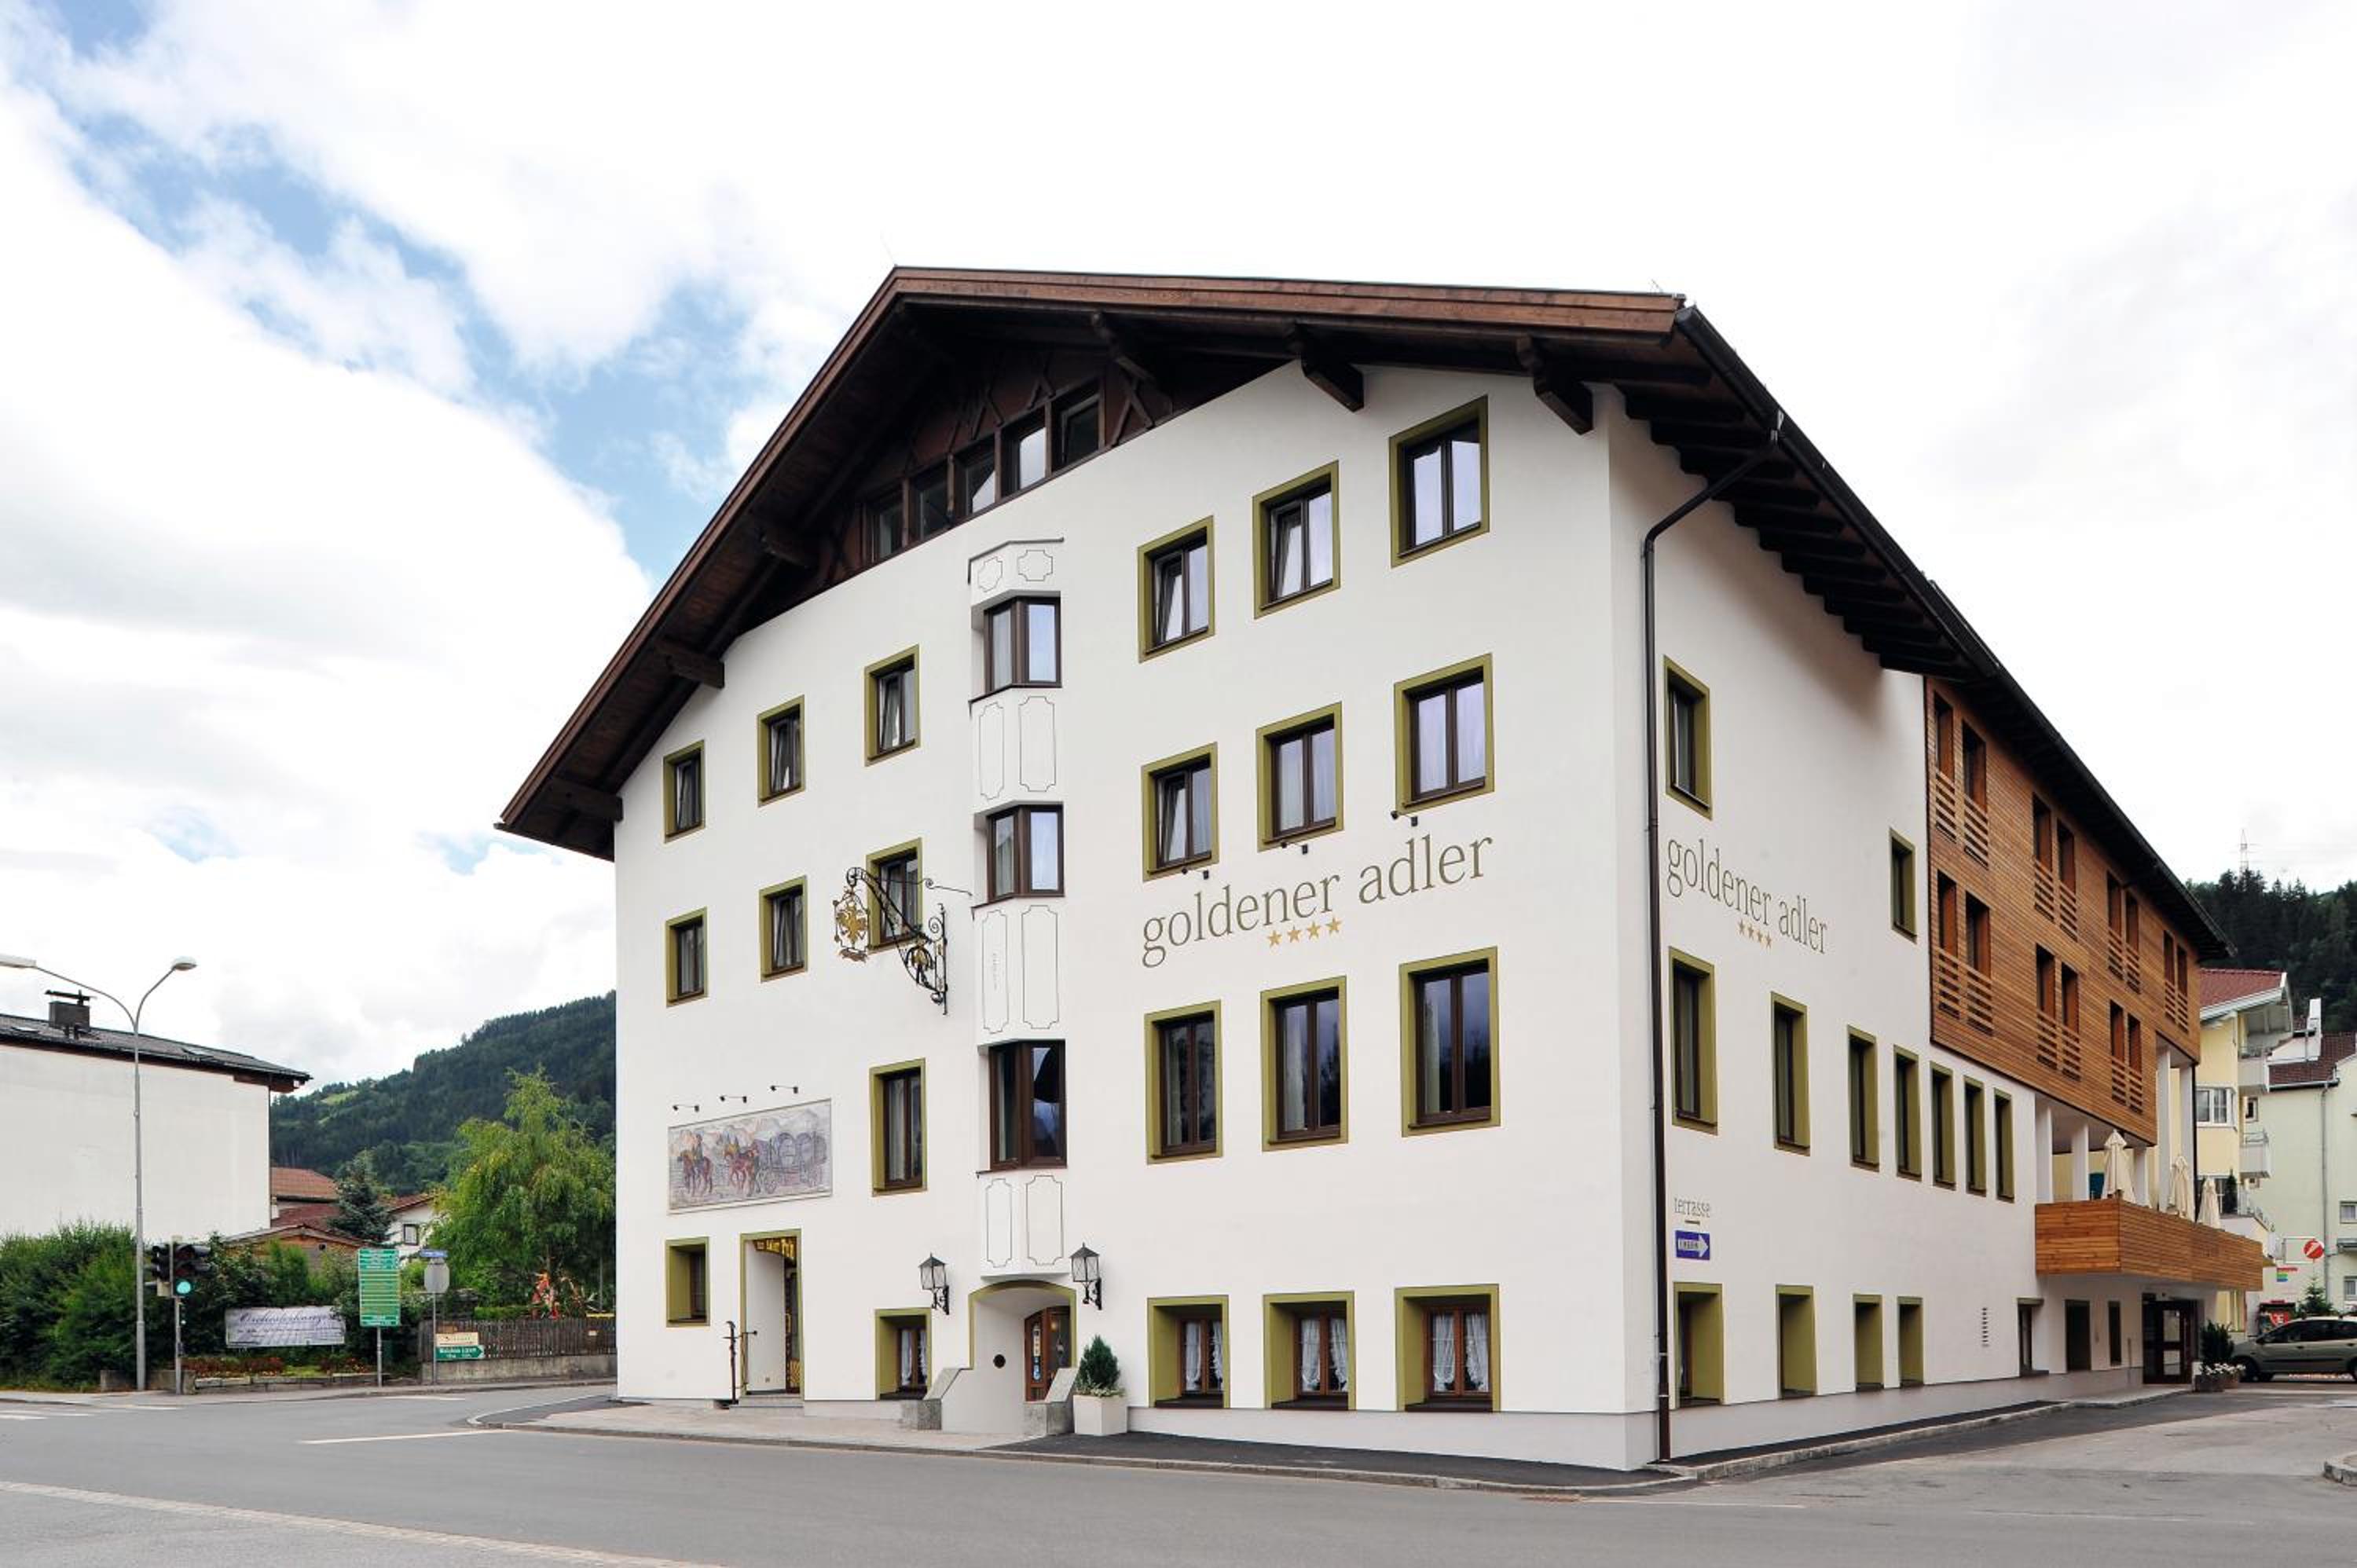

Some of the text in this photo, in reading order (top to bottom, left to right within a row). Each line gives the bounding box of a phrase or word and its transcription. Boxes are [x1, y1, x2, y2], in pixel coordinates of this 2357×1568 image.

[1142, 833, 1493, 968] goldener adler
[1666, 838, 1828, 954] goldener adler
